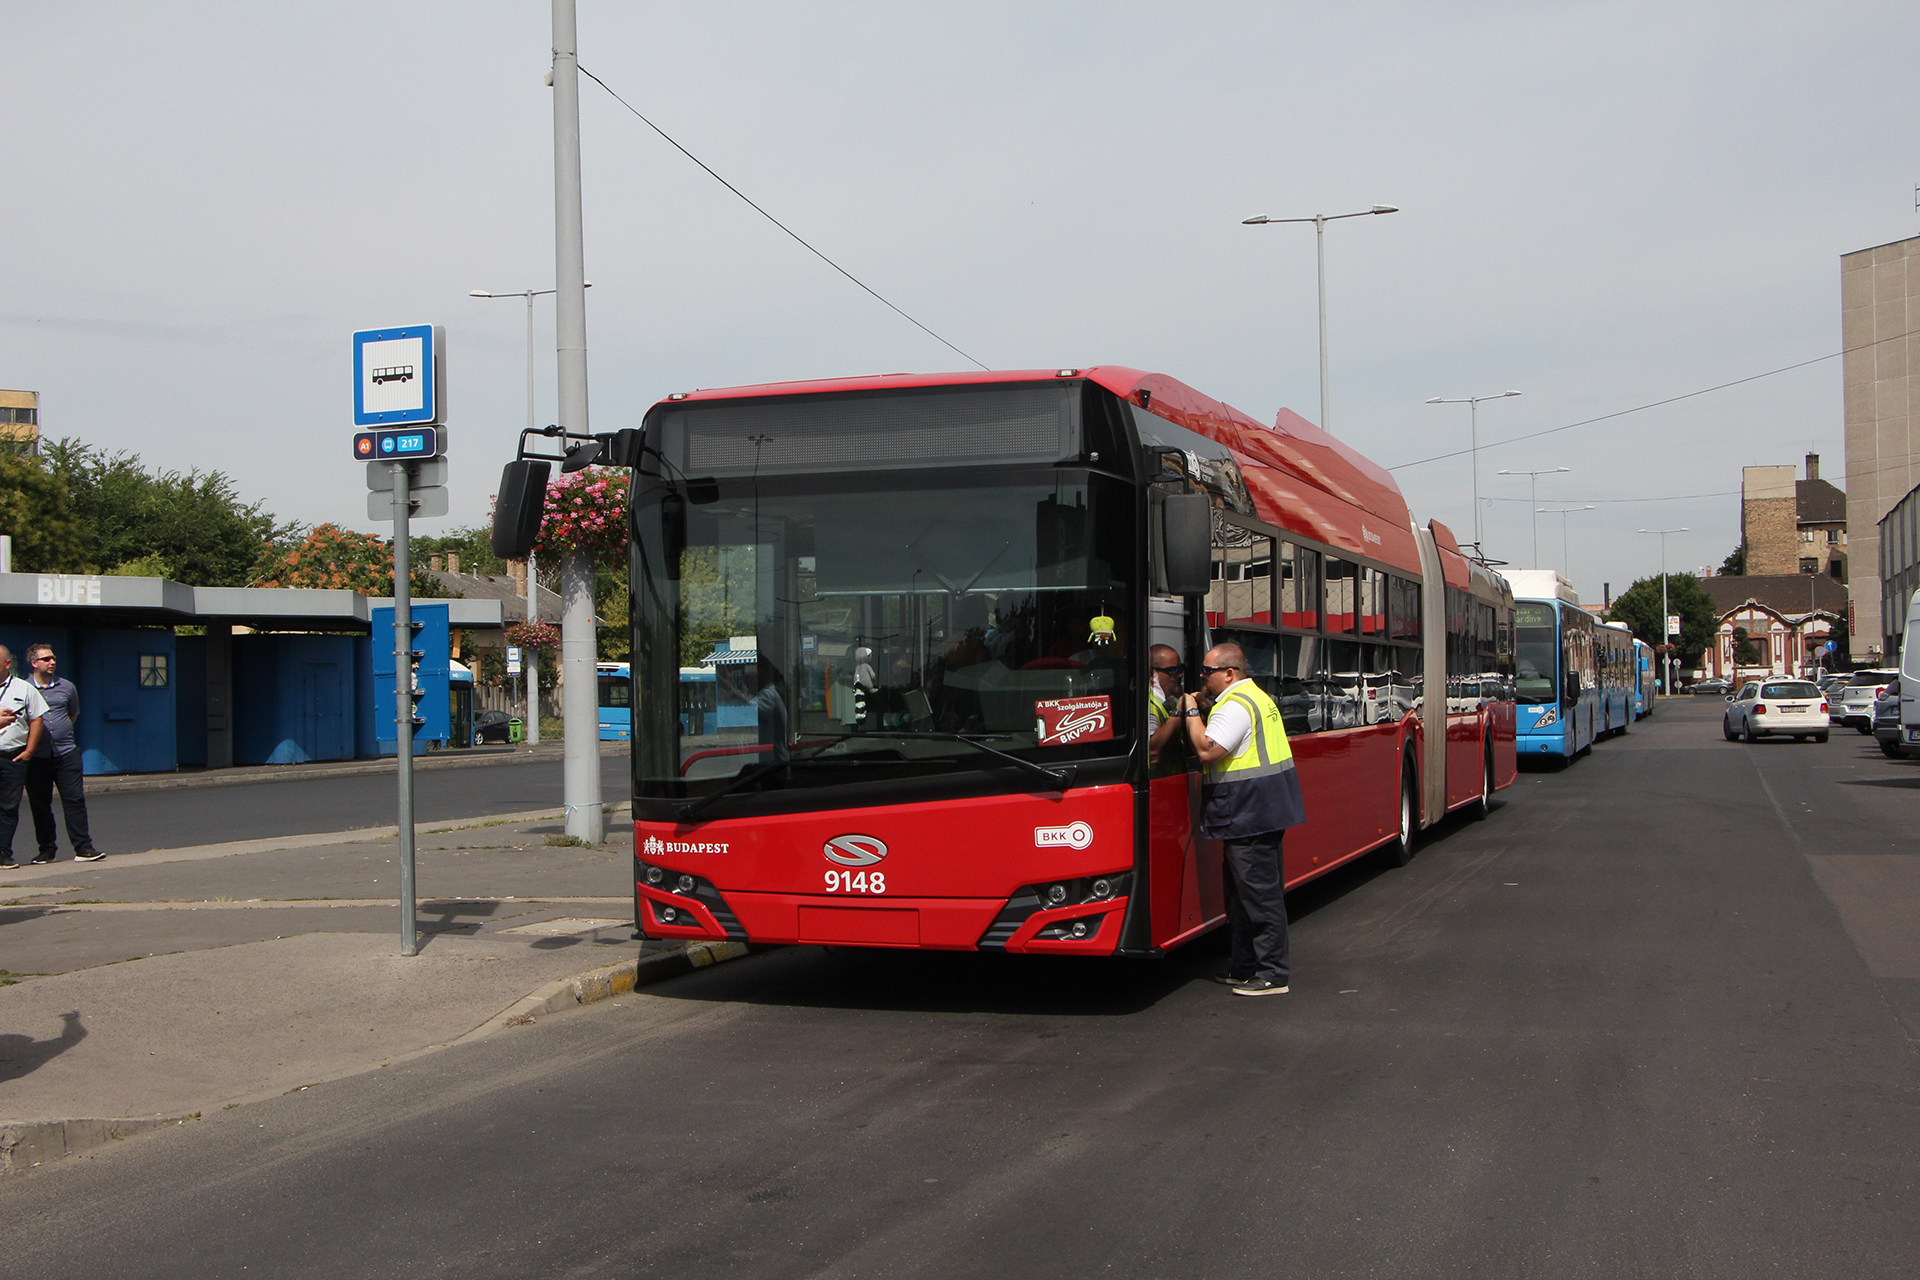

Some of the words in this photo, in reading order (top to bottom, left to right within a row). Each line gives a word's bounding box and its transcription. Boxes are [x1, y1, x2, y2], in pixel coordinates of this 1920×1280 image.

[360, 442, 370, 451] A1
[401, 438, 419, 449] 217
[37, 574, 101, 604] BÜFÉ
[1037, 701, 1044, 709] A
[1044, 700, 1060, 708] BKK
[1057, 700, 1102, 712] szolgáltatója
[1059, 728, 1081, 744] BKV
[1042, 831, 1067, 842] BKK
[665, 842, 730, 854] BUDAPEST
[824, 869, 887, 895] 9148
